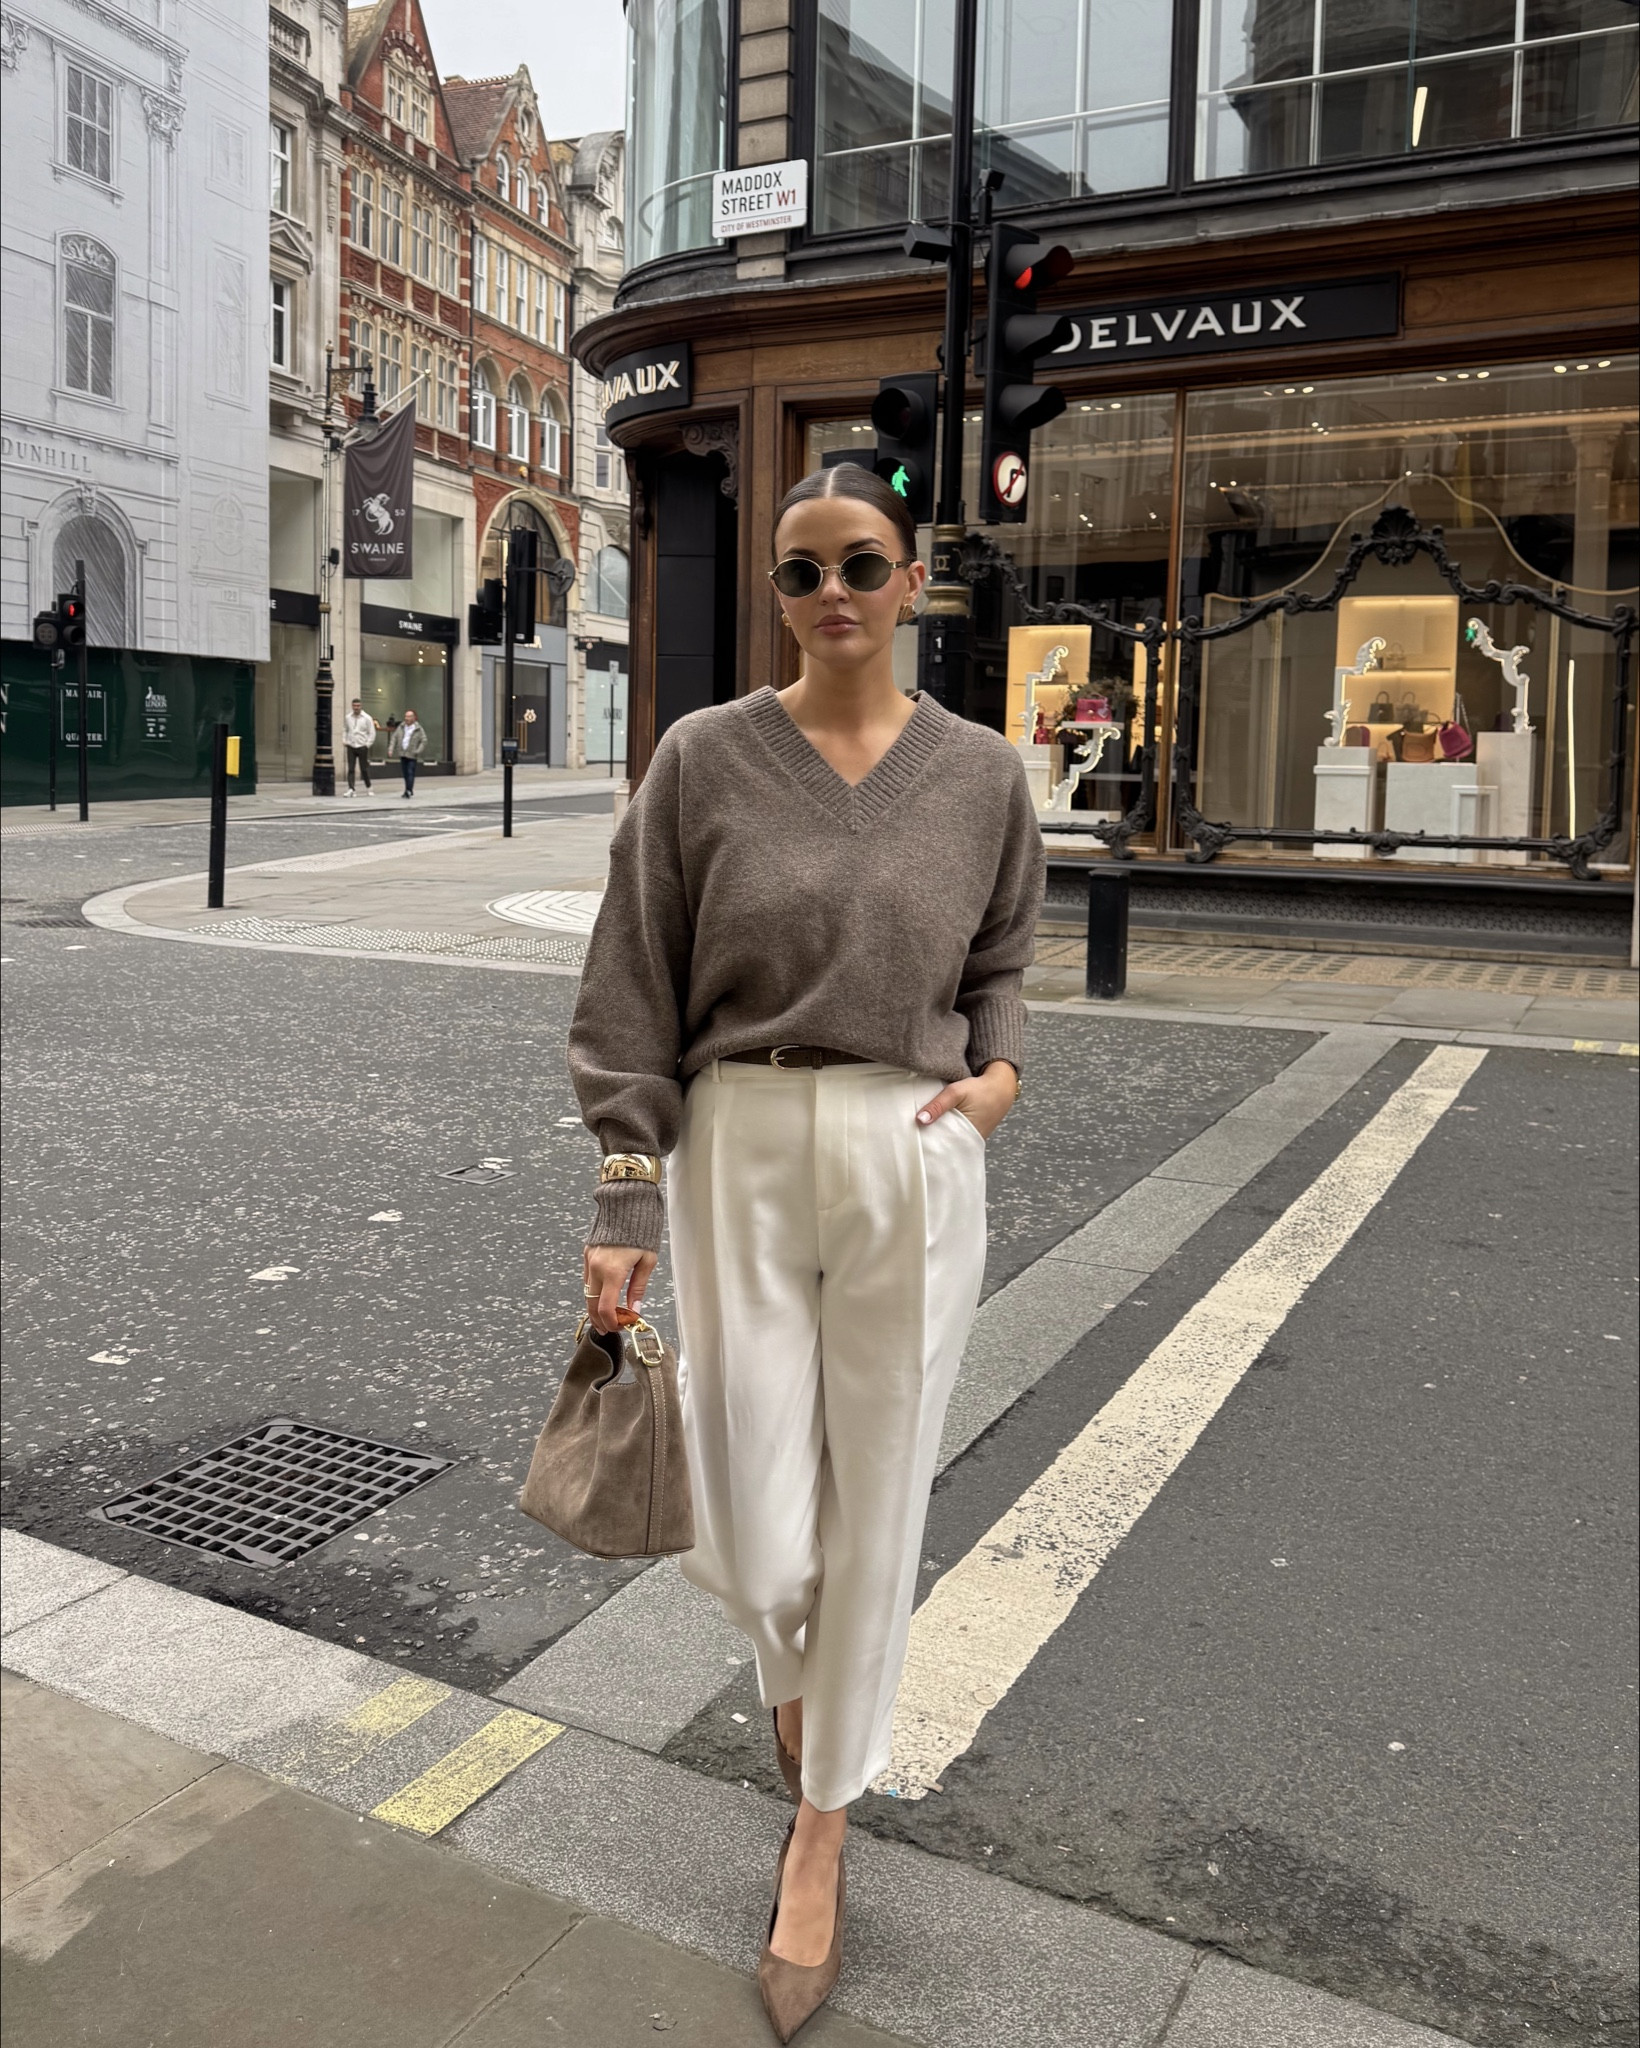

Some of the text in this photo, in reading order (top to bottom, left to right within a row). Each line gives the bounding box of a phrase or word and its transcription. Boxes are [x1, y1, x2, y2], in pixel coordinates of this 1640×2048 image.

[721, 171, 782, 196] MADDOX
[721, 188, 796, 215] STREET W1
[721, 215, 792, 233] CITY OF WESTMINSTER
[1, 436, 92, 473] DUNHILL
[351, 542, 404, 554] SWAINE
[399, 620, 423, 632] SWAINE
[65, 689, 102, 698] MAAIR
[65, 733, 102, 742] QUTER
